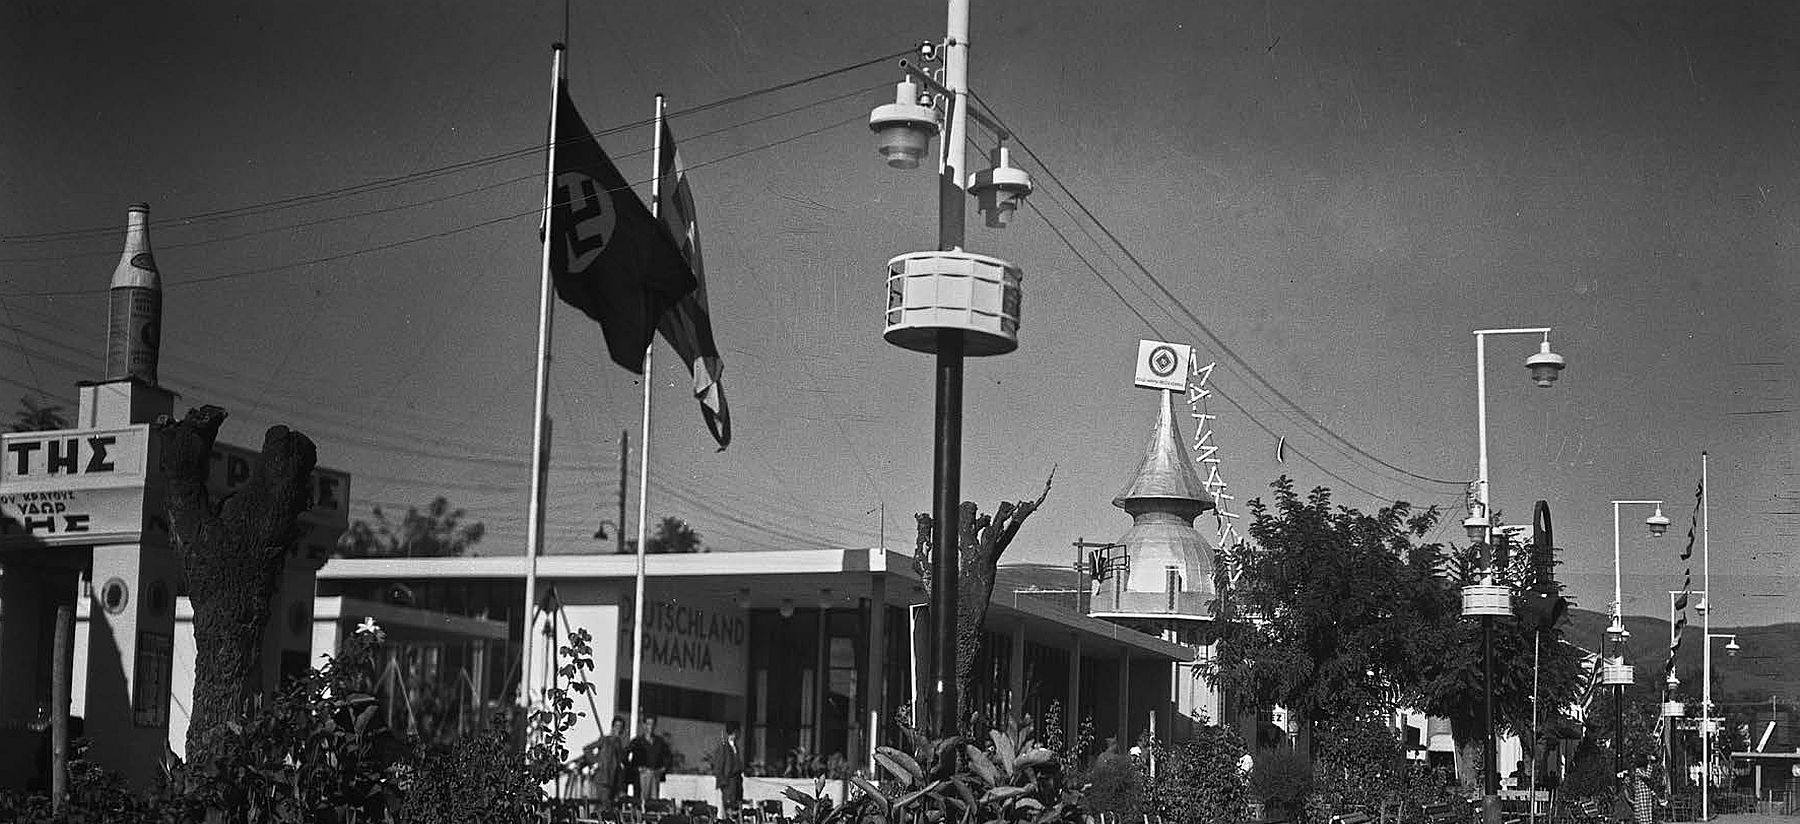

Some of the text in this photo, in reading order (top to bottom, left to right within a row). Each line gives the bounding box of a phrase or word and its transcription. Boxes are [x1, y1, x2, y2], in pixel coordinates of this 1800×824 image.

[7, 436, 116, 475] ΤΗΣ
[18, 502, 66, 515] ΥΔΩΡ
[621, 595, 745, 646] DUTSCHLAND
[620, 628, 713, 672] ΓΡΜΑΝΙΑ
